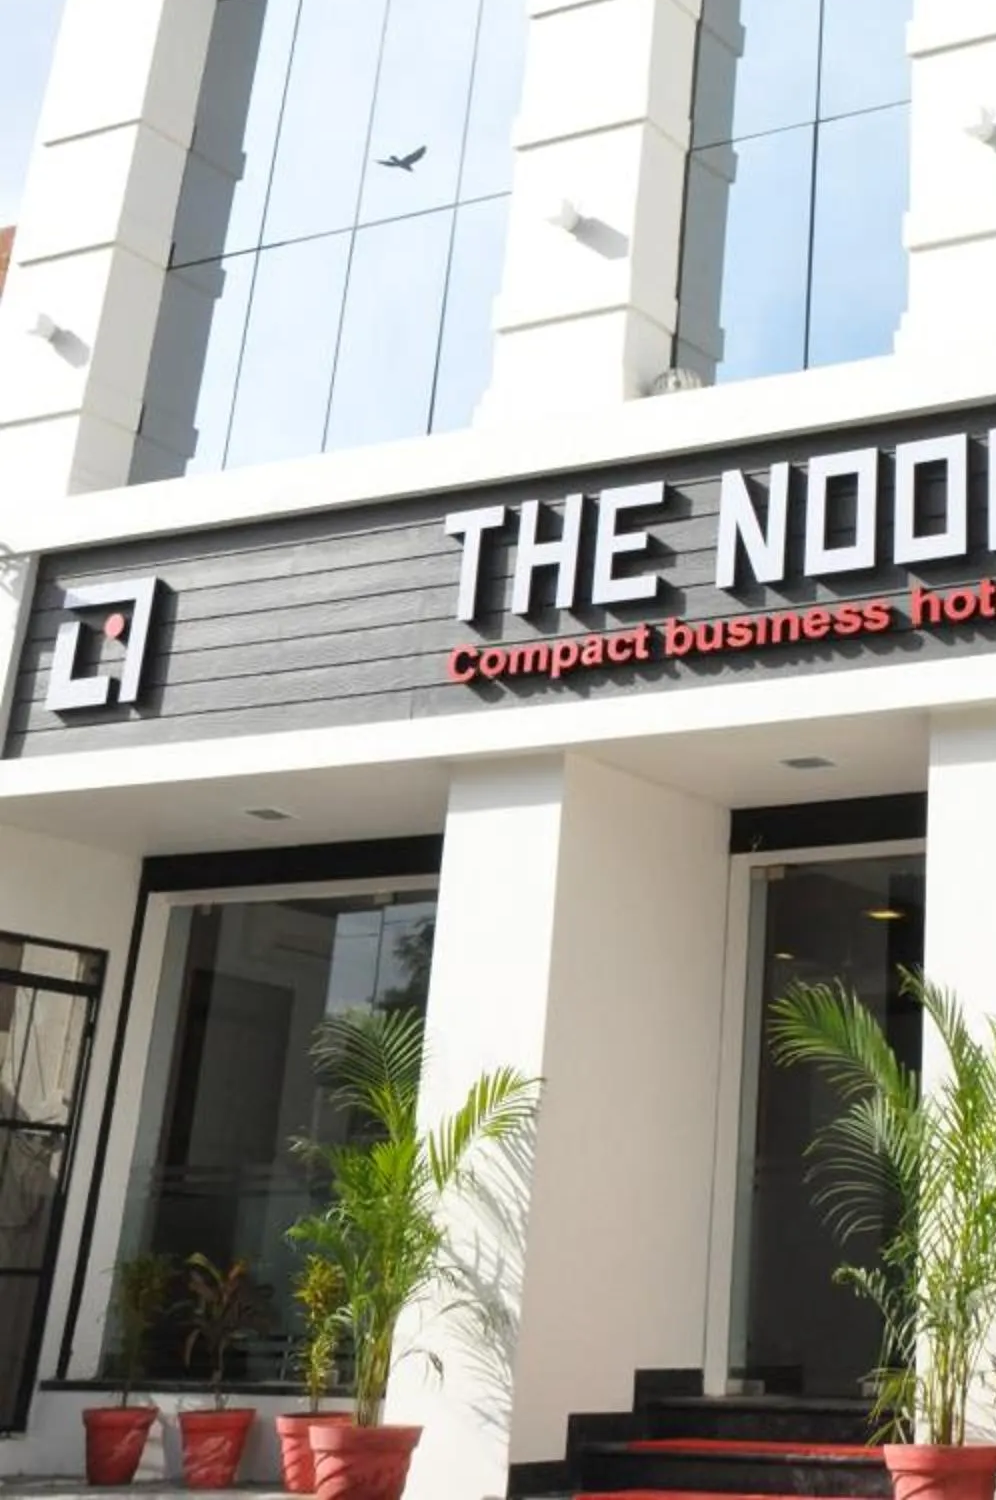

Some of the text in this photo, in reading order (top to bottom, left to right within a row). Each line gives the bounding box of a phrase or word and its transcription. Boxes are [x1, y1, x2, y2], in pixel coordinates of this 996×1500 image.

[444, 480, 665, 621] THE
[447, 622, 650, 683] Compact
[664, 597, 892, 656] business
